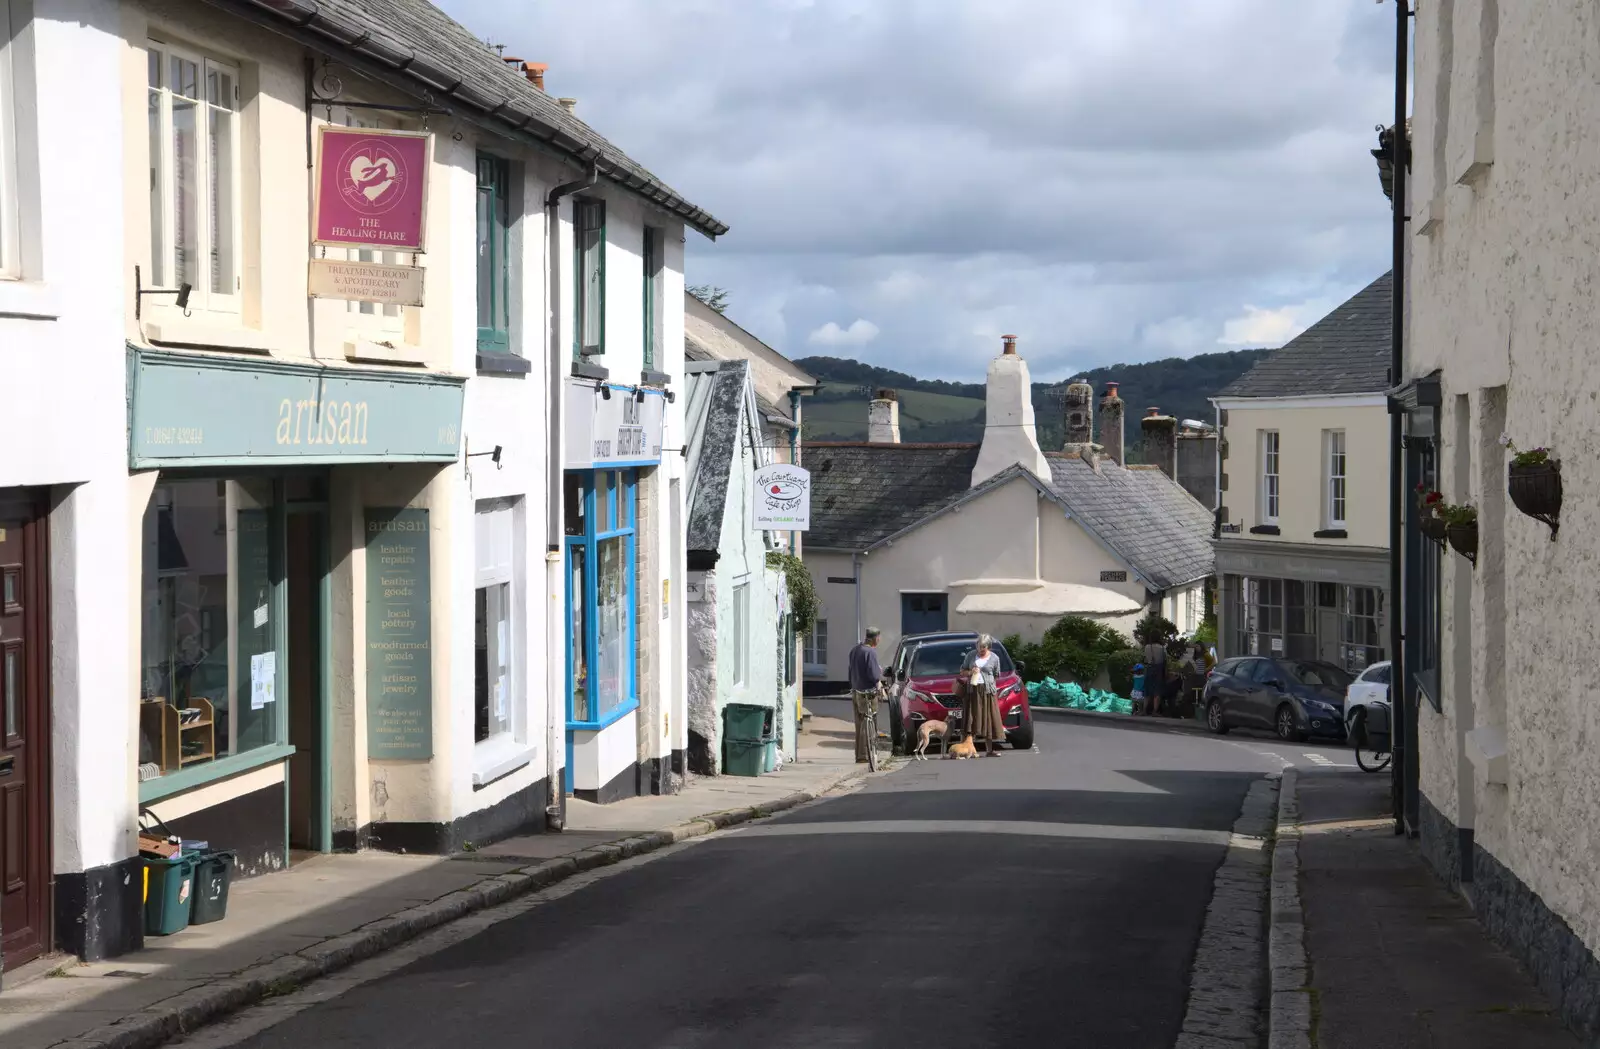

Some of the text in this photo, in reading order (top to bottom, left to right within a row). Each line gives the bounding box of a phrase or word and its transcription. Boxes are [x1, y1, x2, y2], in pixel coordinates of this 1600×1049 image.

[360, 217, 380, 228] THE
[332, 227, 406, 241] HEALING HARE
[328, 265, 409, 280] TREATMENT ROOM
[341, 277, 400, 289] APOTHECARY
[276, 383, 368, 445] artisan
[757, 475, 769, 486] The
[368, 517, 427, 532] artisan
[381, 544, 416, 554] leather
[381, 555, 415, 566] repairs
[381, 577, 416, 586] leather
[384, 587, 414, 598] goods
[388, 609, 410, 618] local
[381, 619, 417, 629] pottery
[370, 640, 428, 649] woodturned
[385, 651, 414, 662] goods
[382, 674, 416, 683] artisan
[382, 684, 417, 695] jewelry
